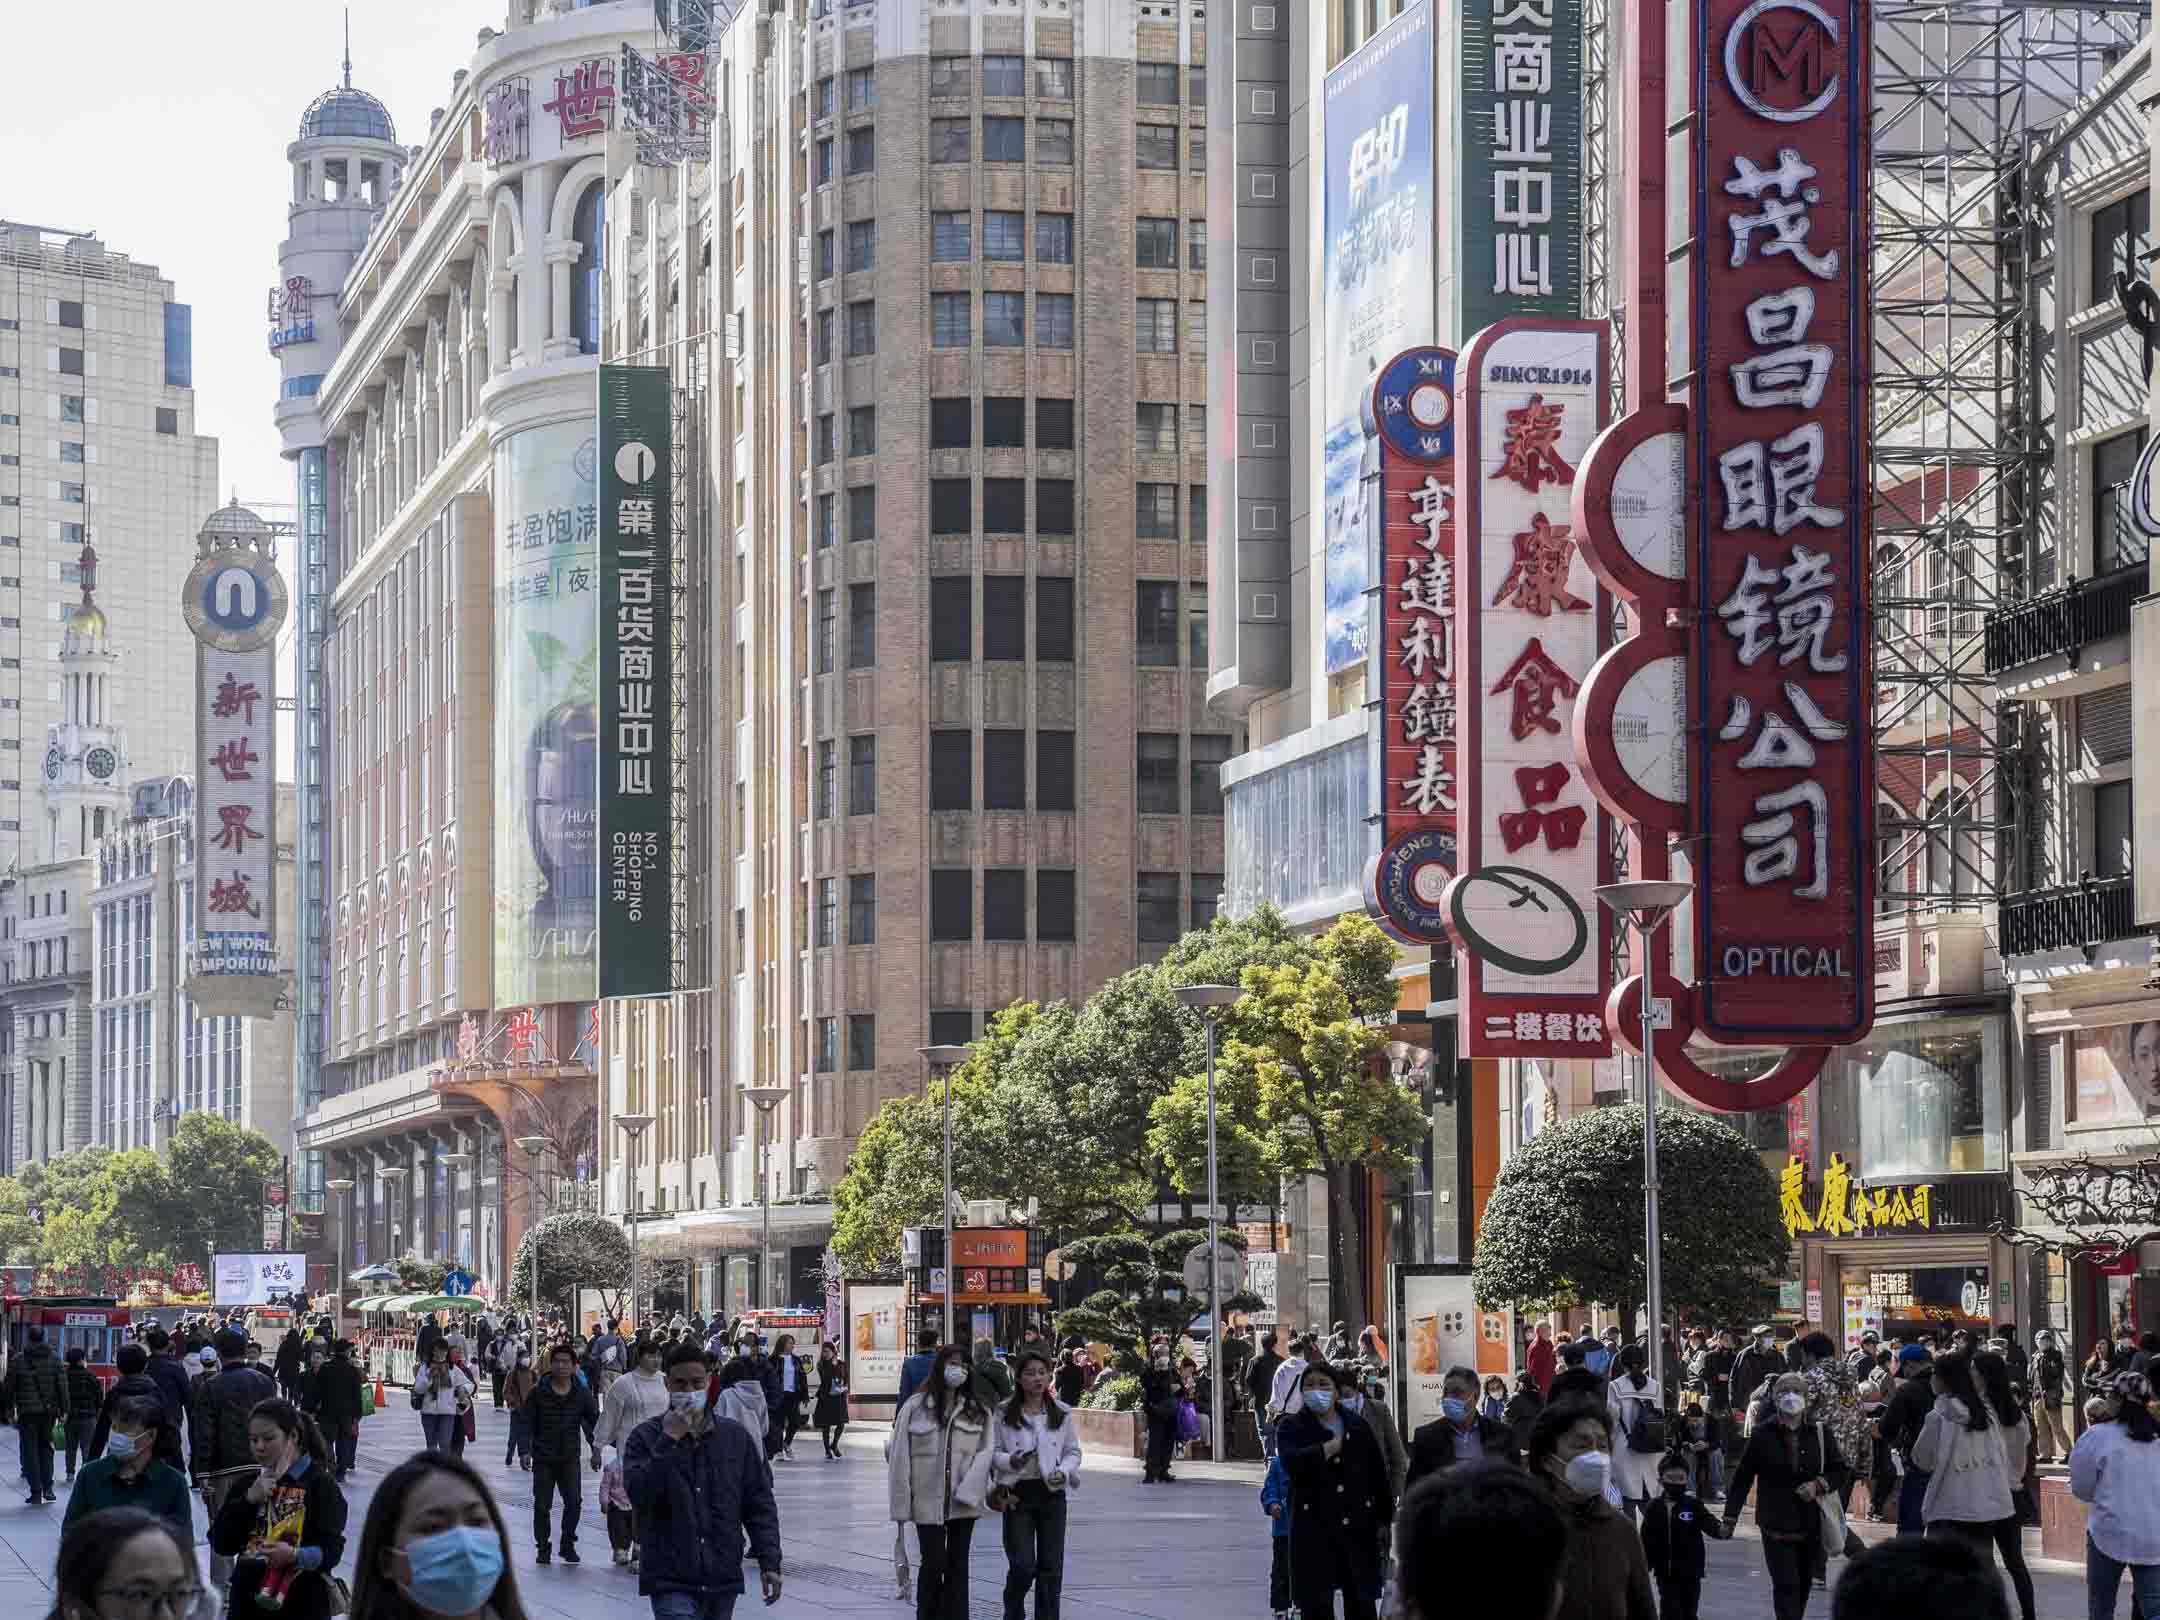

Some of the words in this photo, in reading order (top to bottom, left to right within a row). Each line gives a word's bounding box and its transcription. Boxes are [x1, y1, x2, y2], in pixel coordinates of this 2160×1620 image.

[1718, 149, 1848, 900] 茂昌眼镜公司
[617, 496, 653, 794] 第一百货商业中心
[208, 672, 264, 919] 新世界城
[613, 832, 626, 901] CENTER
[629, 832, 642, 922] SHOPPING
[645, 832, 657, 870] NO.1
[1723, 946, 1851, 978] OPTICAL
[1485, 1011, 1603, 1042] 二楼餐饮
